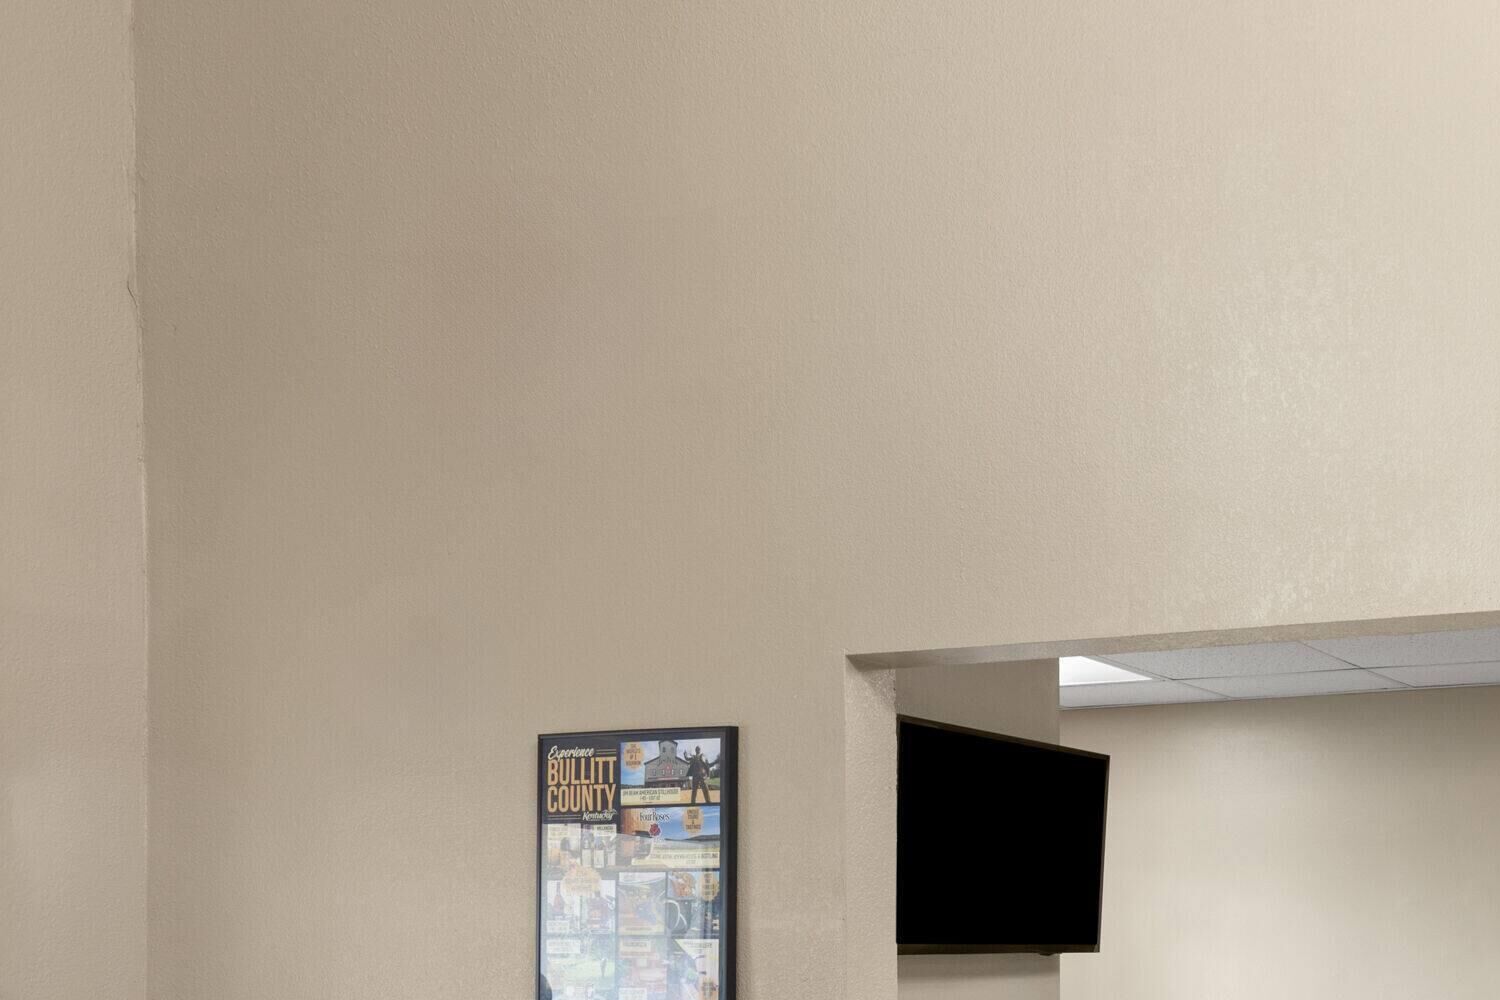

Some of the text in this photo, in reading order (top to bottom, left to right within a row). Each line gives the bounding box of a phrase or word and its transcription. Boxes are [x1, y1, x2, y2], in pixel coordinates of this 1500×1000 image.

[548, 745, 595, 761] Experience
[547, 756, 617, 786] BULLITT
[547, 784, 617, 813] COUNTY
[582, 809, 618, 821] Kentucky
[639, 810, 670, 822] Four Roses
